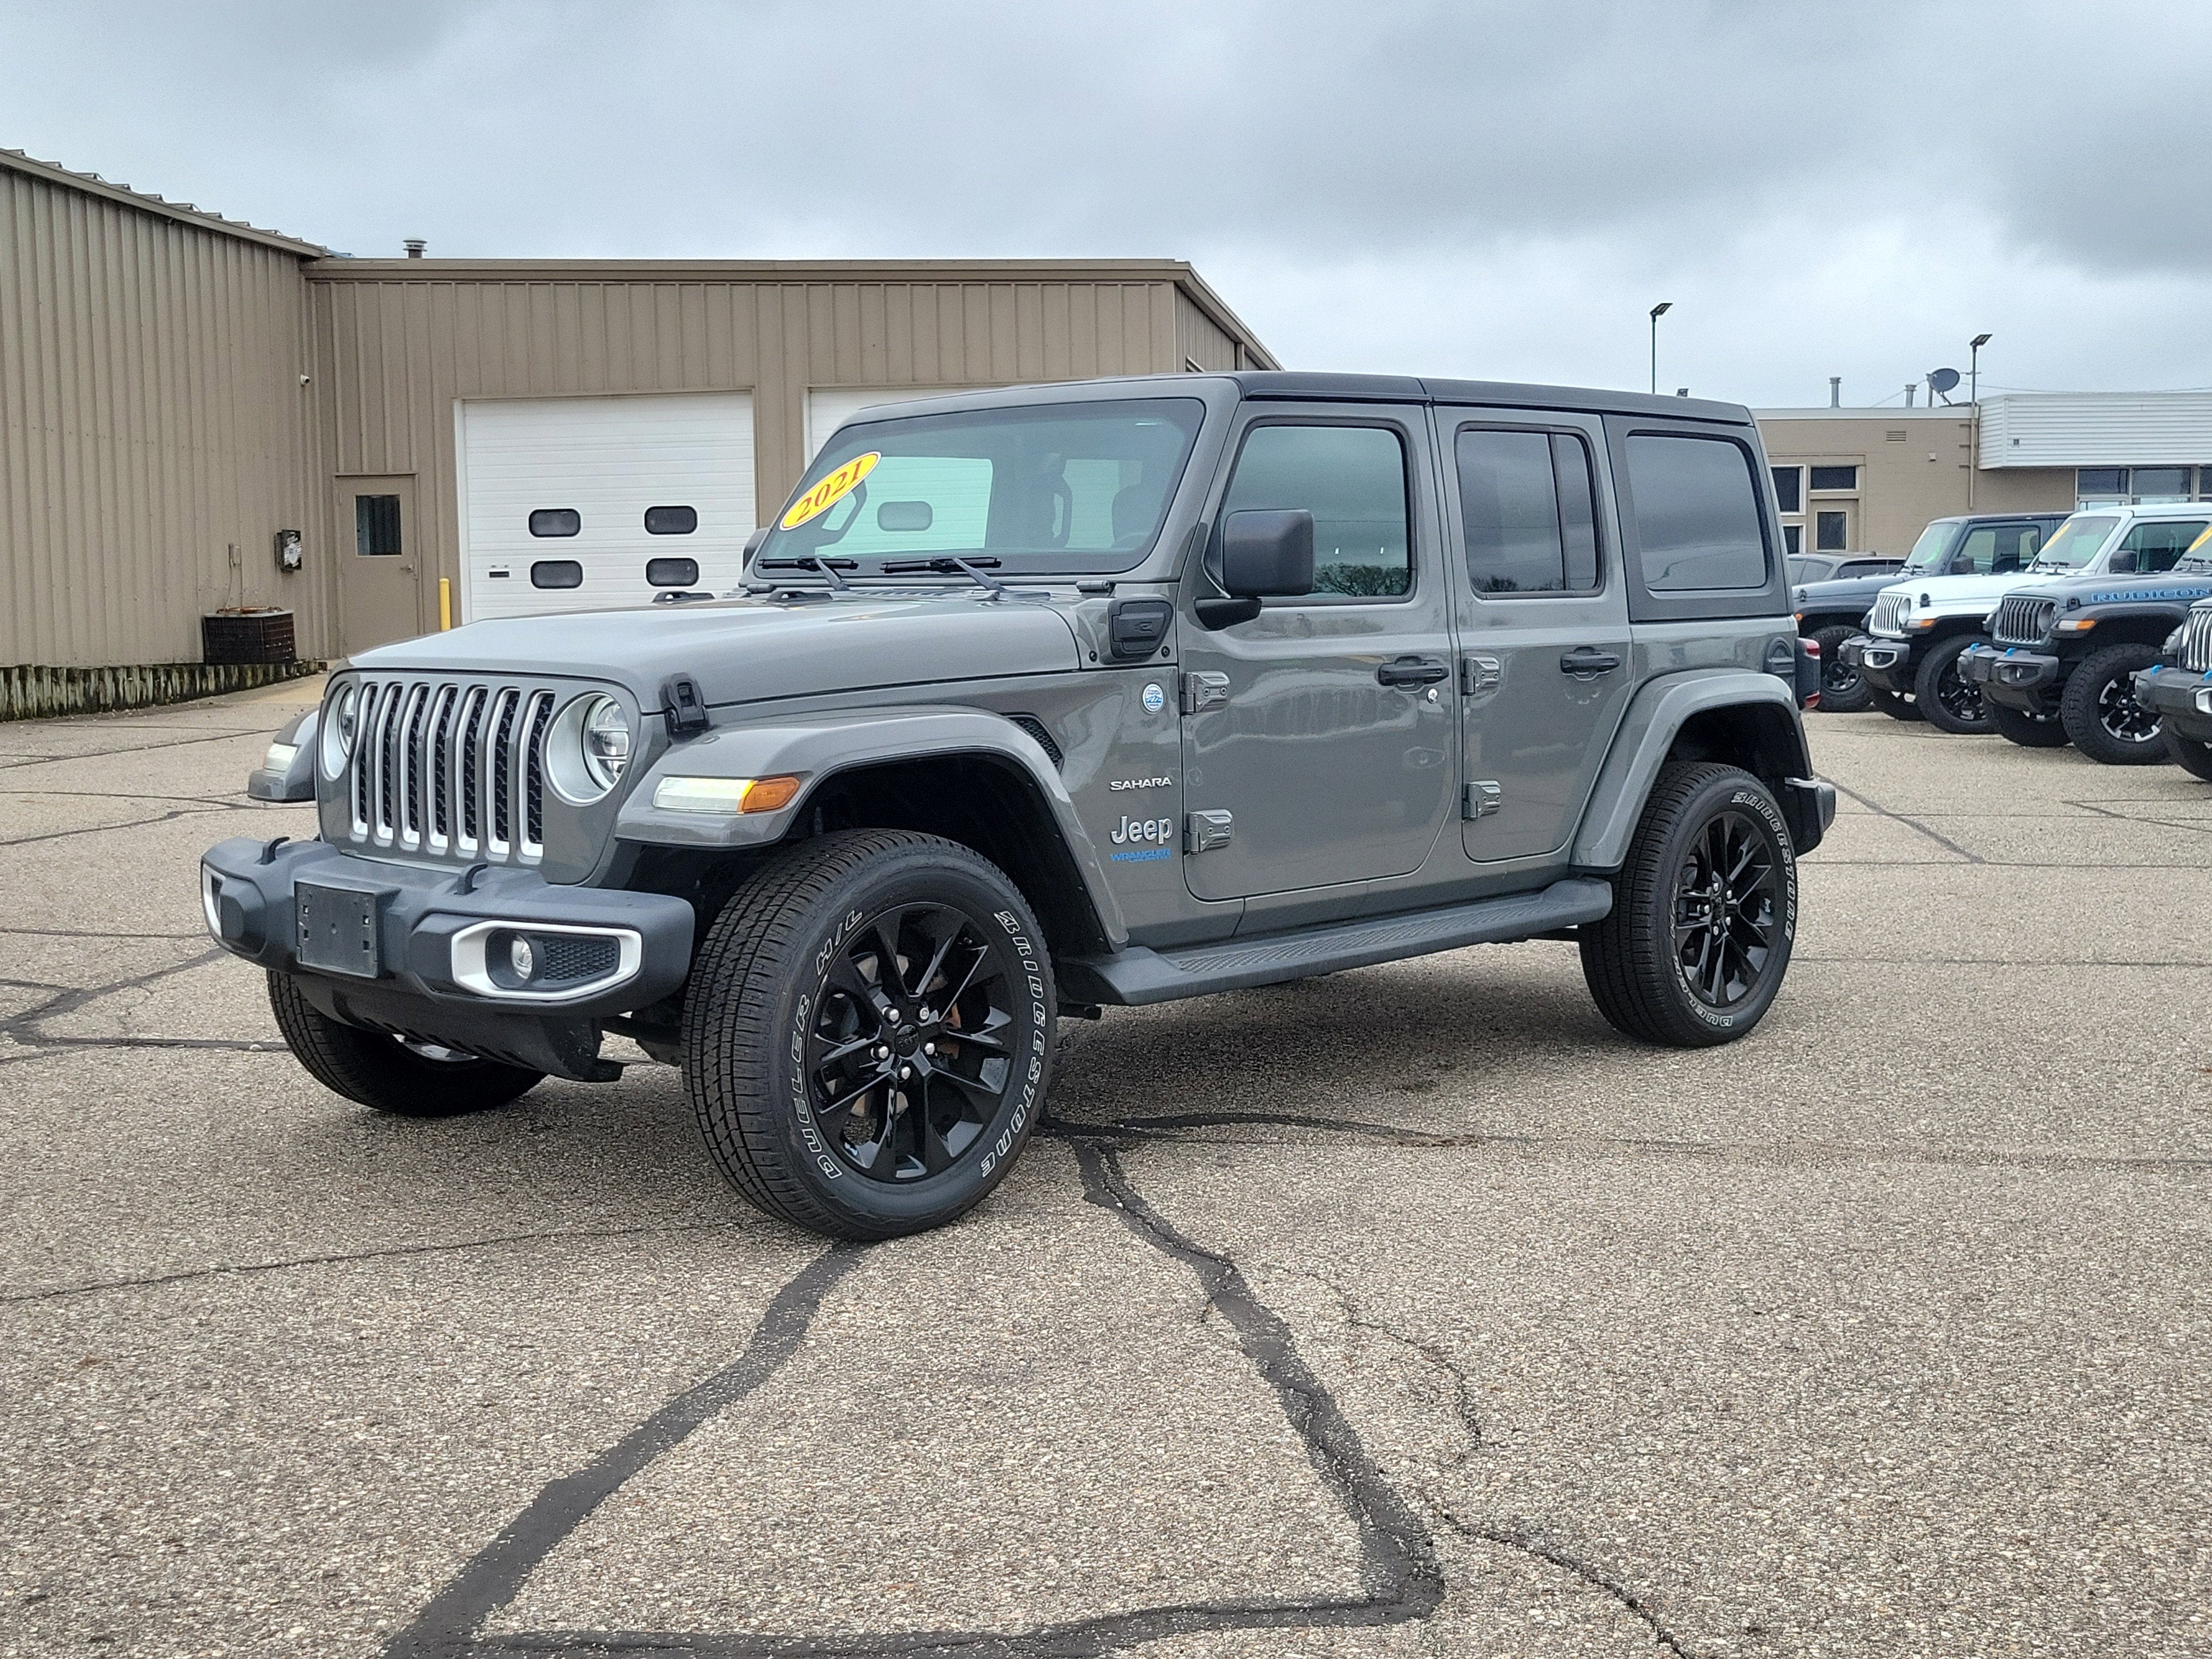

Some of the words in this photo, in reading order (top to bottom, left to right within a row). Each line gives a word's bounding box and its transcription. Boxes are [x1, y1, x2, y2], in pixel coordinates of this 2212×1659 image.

[796, 460, 863, 522] 2021
[2091, 587, 2212, 602] RUBICON
[1110, 777, 1172, 791] SAHARA
[1111, 815, 1173, 845] Jeep
[1110, 848, 1172, 861] WRANGLER
[1731, 792, 1796, 941] BRIDGESTONE
[981, 910, 1046, 1179] BRIDGESTONE
[791, 994, 843, 1180] DUELER
